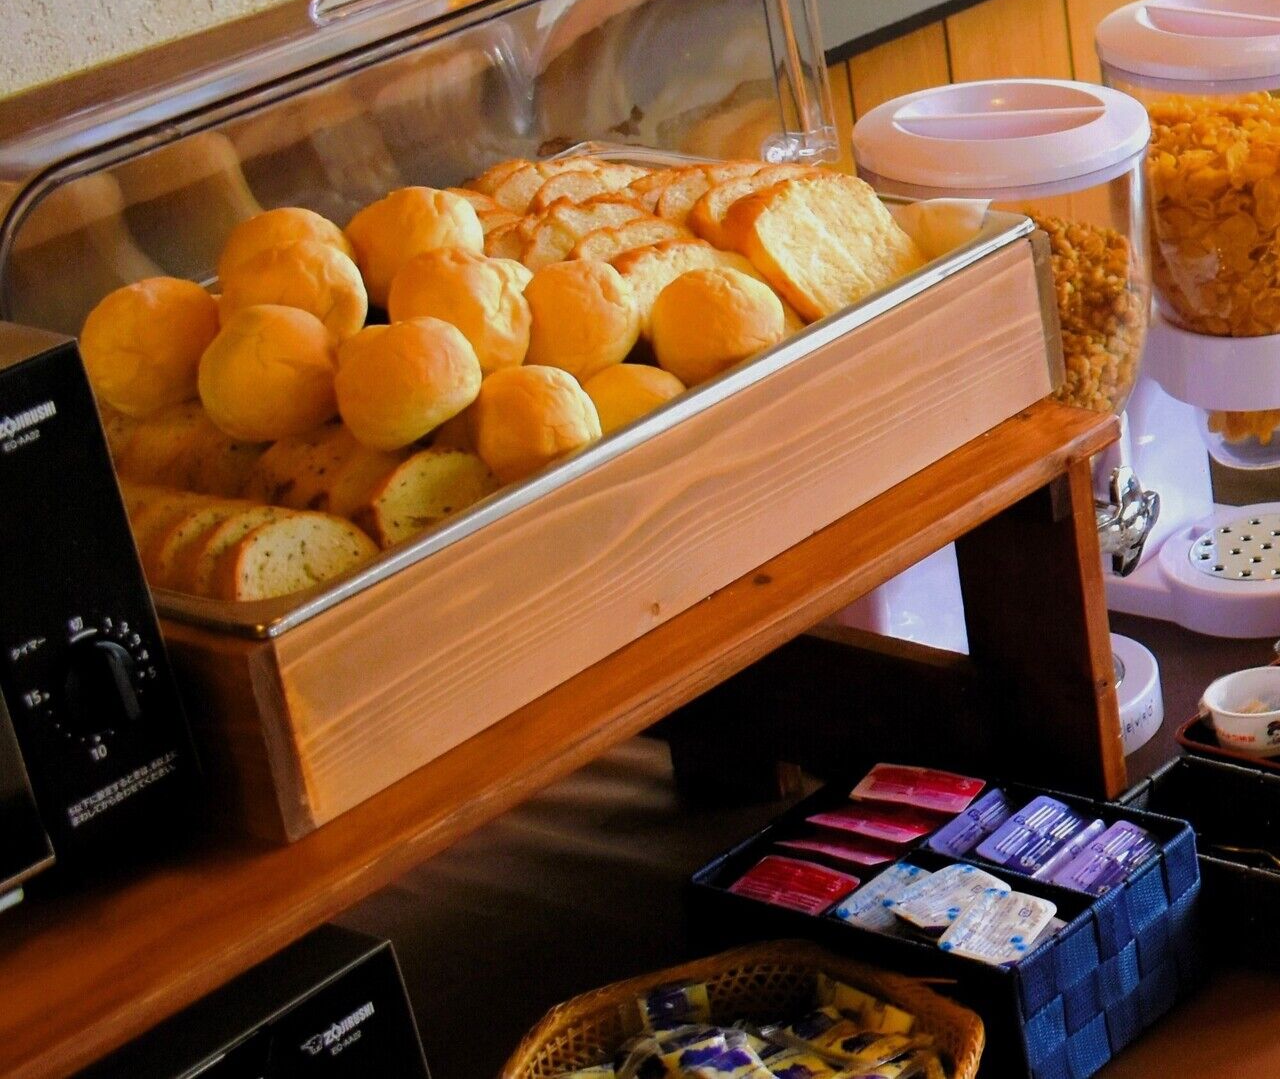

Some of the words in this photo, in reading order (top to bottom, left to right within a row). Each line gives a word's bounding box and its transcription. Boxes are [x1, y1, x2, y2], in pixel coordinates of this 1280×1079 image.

[147, 666, 157, 679] 5
[23, 689, 42, 708] 15
[90, 744, 108, 761] 10
